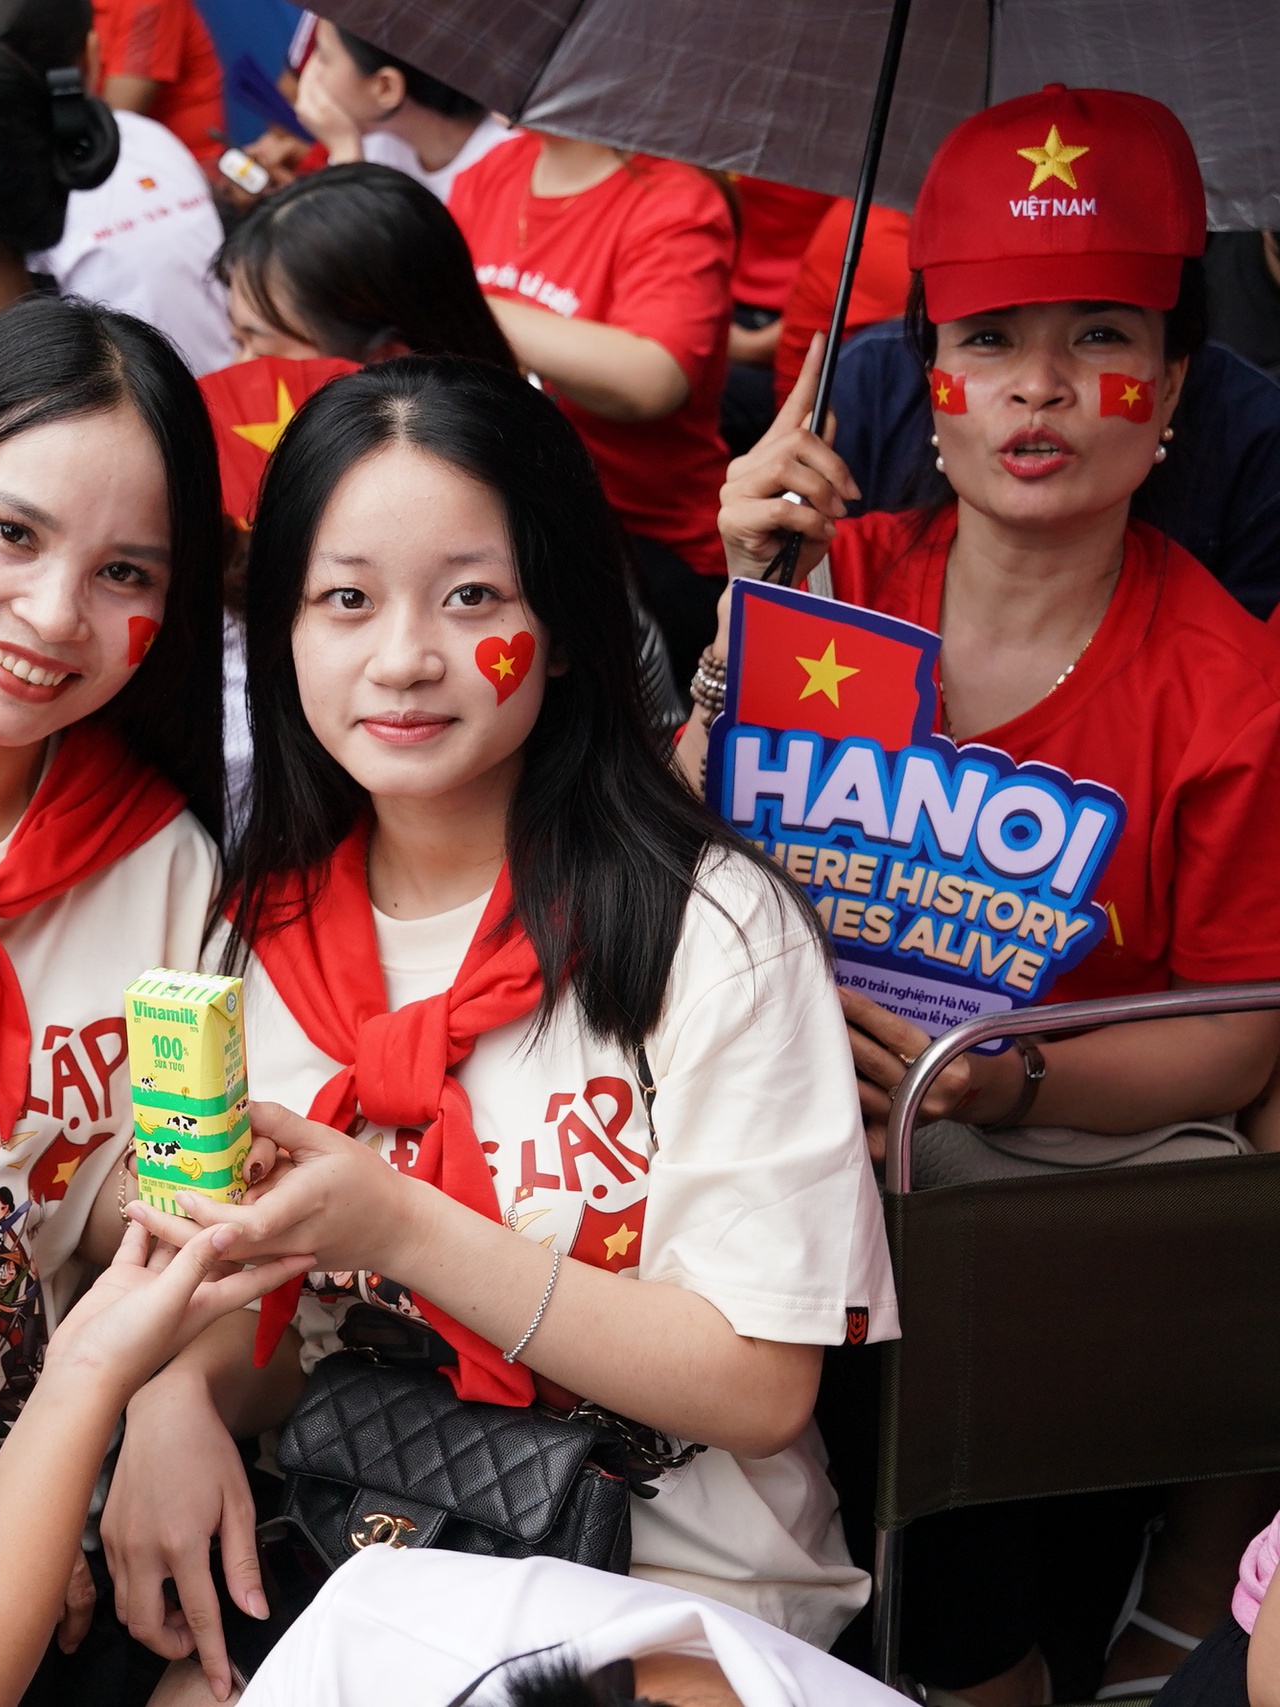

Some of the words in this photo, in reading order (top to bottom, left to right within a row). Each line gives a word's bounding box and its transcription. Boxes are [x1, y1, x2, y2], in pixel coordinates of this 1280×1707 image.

[1009, 195, 1051, 221] VIỆT
[1051, 198, 1098, 217] NAM
[732, 736, 1107, 898] HANOI
[885, 861, 1089, 951] HISTORY
[899, 916, 1045, 992] ALIVE
[133, 1000, 198, 1025] Vinamilk
[850, 975, 867, 989] 80
[868, 979, 890, 994] trải
[889, 985, 937, 1005] nghiệm
[939, 994, 957, 1010] Hà
[957, 999, 981, 1017] Nội
[19, 1016, 128, 1131] LẬP
